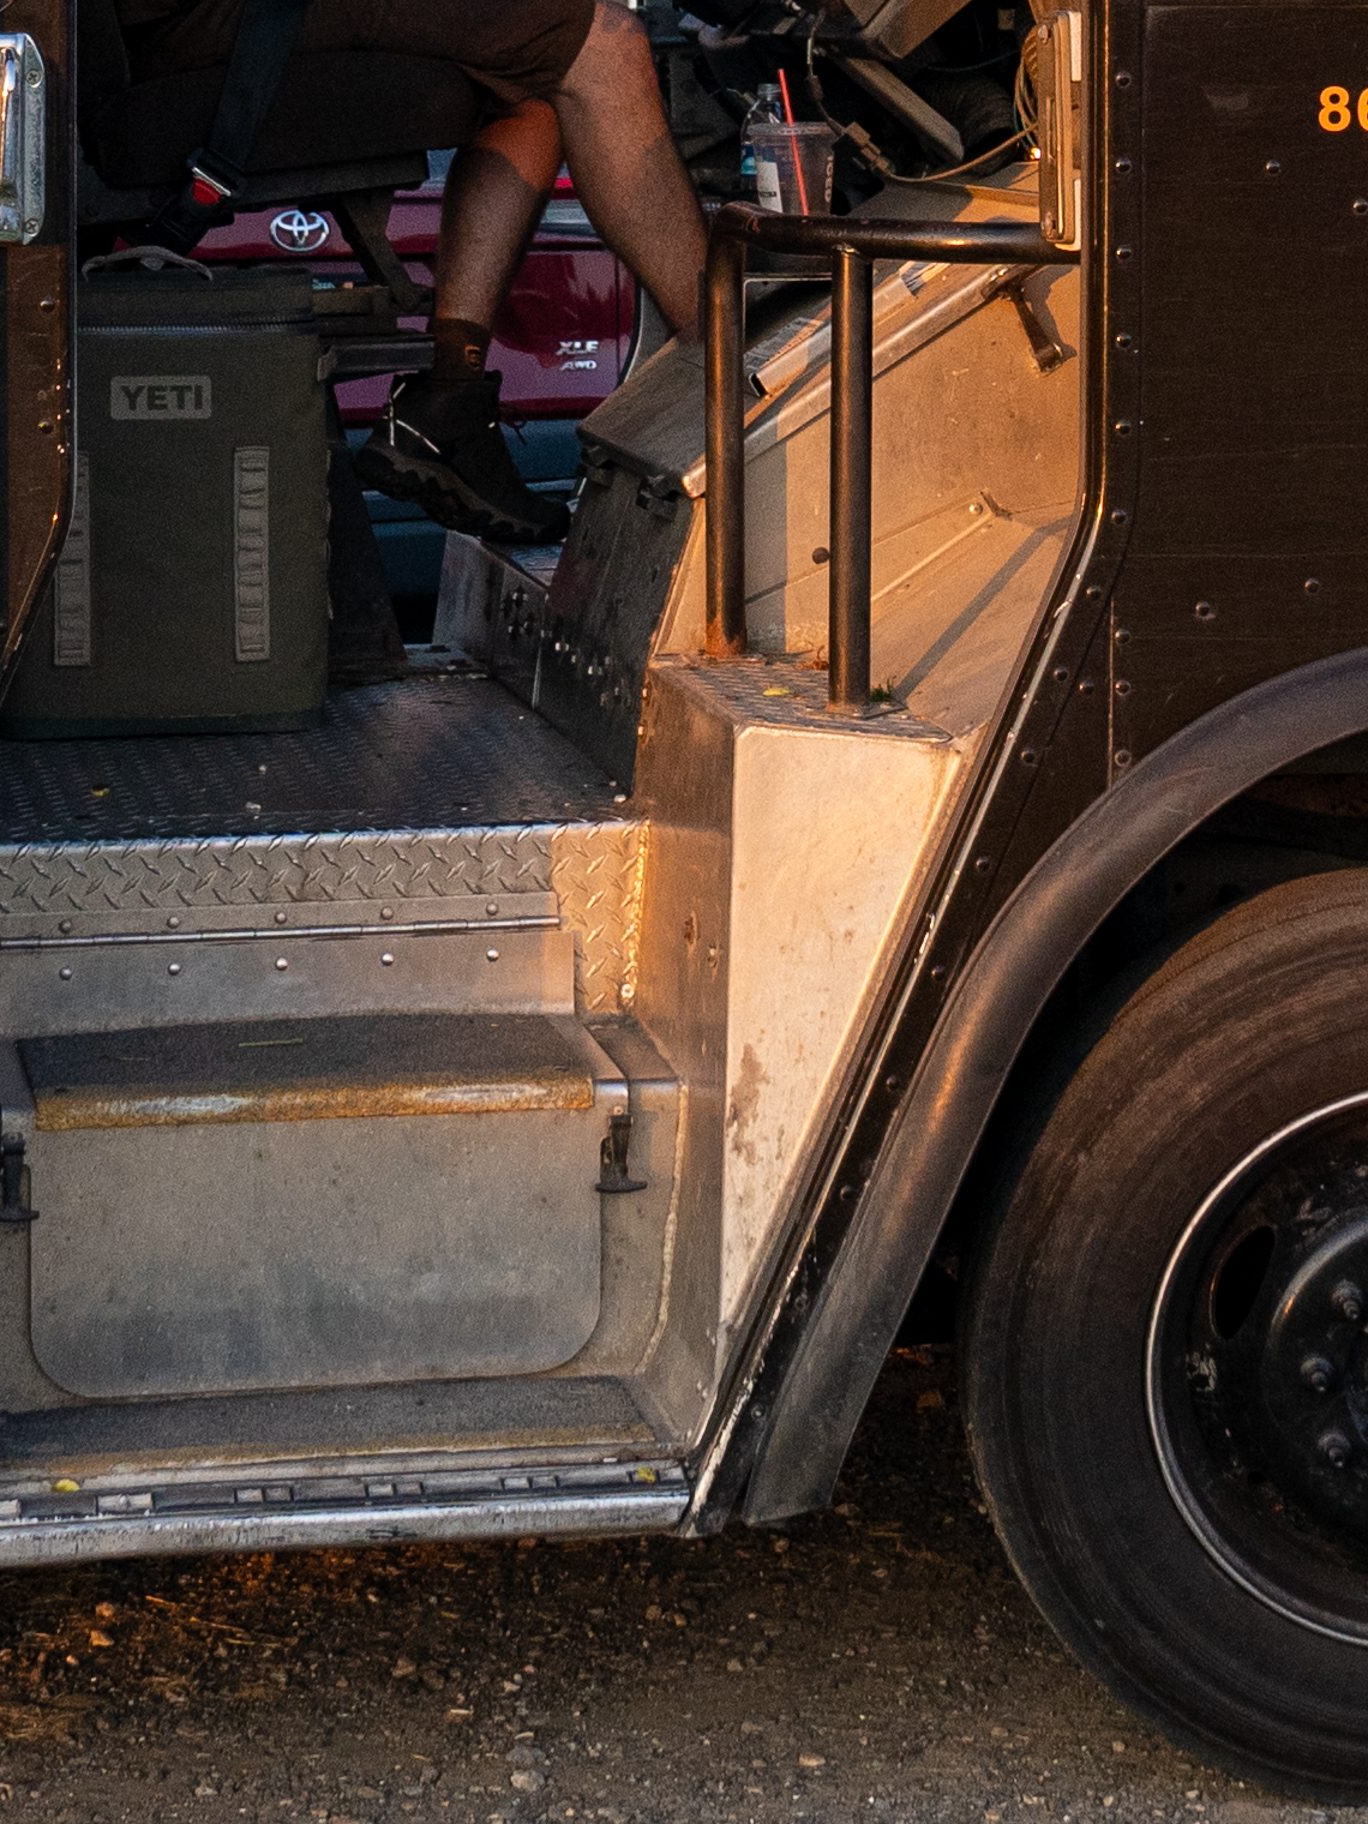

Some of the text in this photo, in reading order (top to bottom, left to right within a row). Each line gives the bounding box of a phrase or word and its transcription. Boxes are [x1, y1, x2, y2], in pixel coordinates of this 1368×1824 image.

[555, 339, 600, 357] XLE
[559, 359, 598, 371] AWD
[120, 384, 203, 411] YETI
